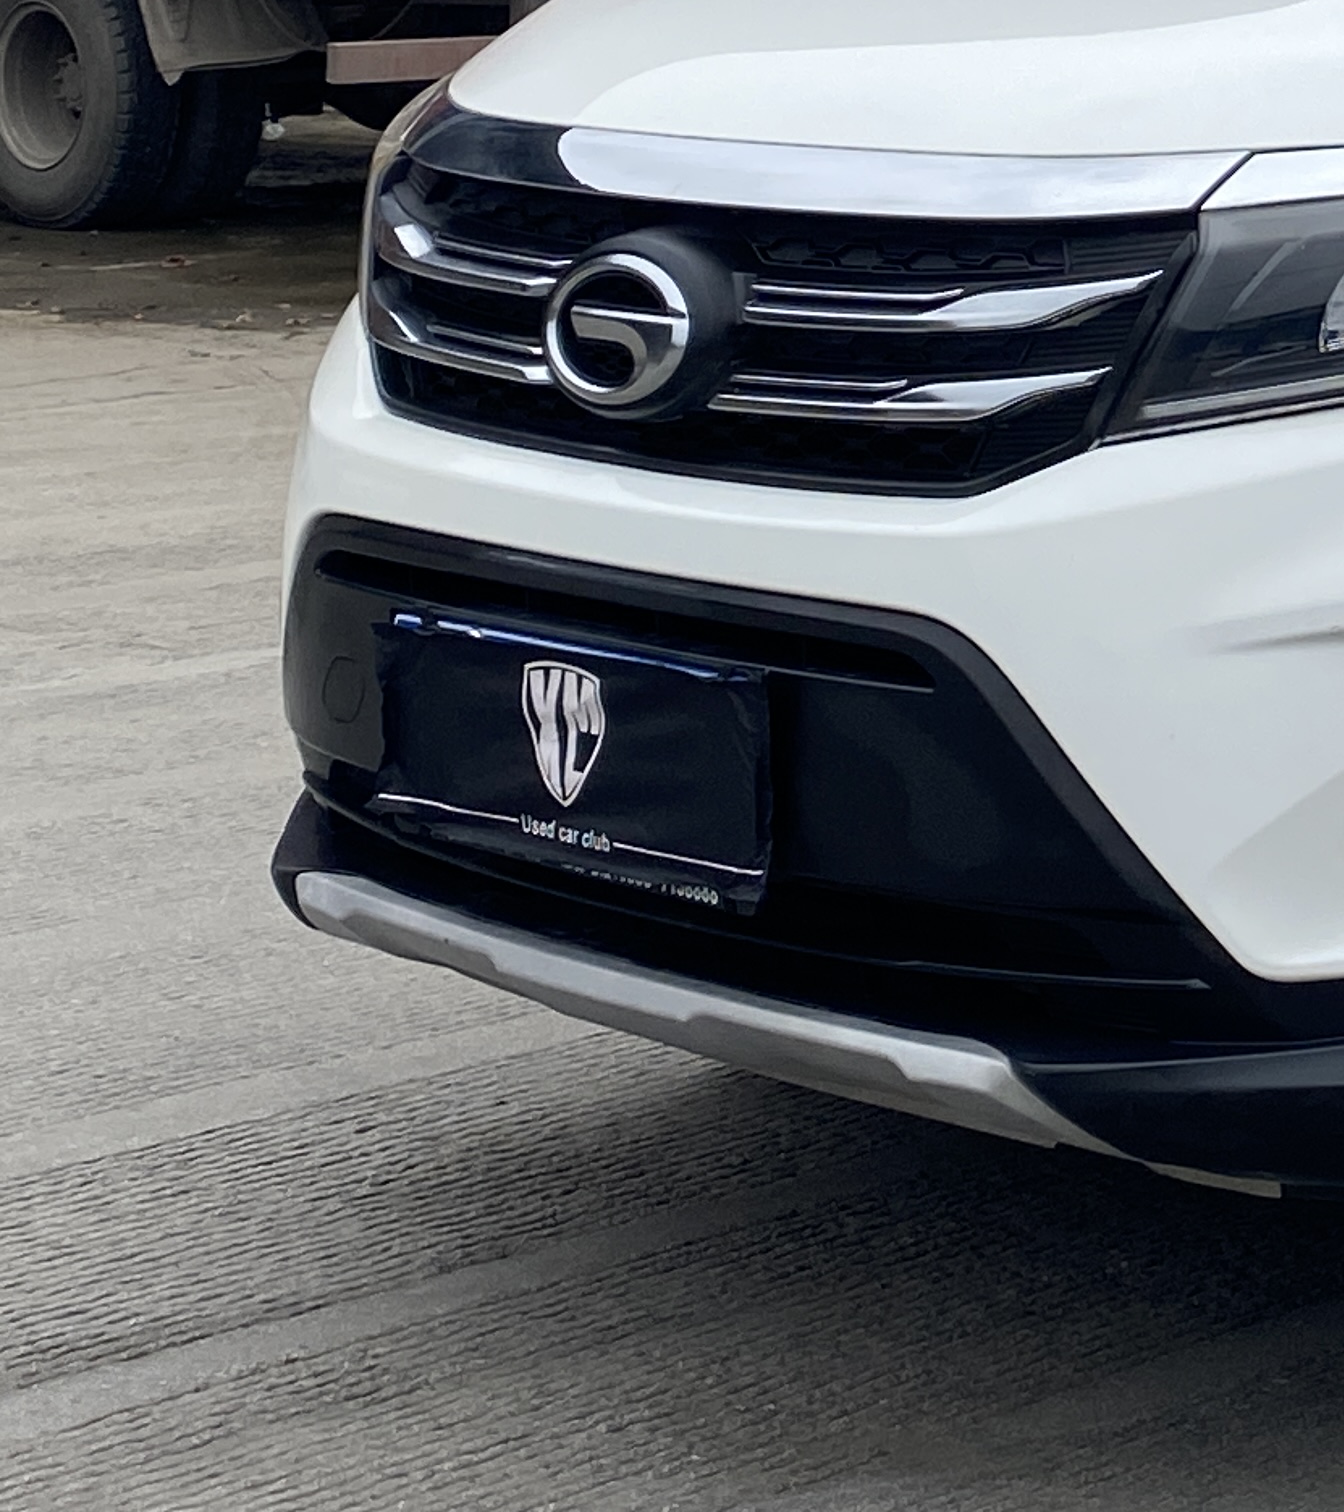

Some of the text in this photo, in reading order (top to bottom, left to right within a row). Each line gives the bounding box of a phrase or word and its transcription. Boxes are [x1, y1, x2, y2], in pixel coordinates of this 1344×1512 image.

[519, 813, 611, 853] Used car club
